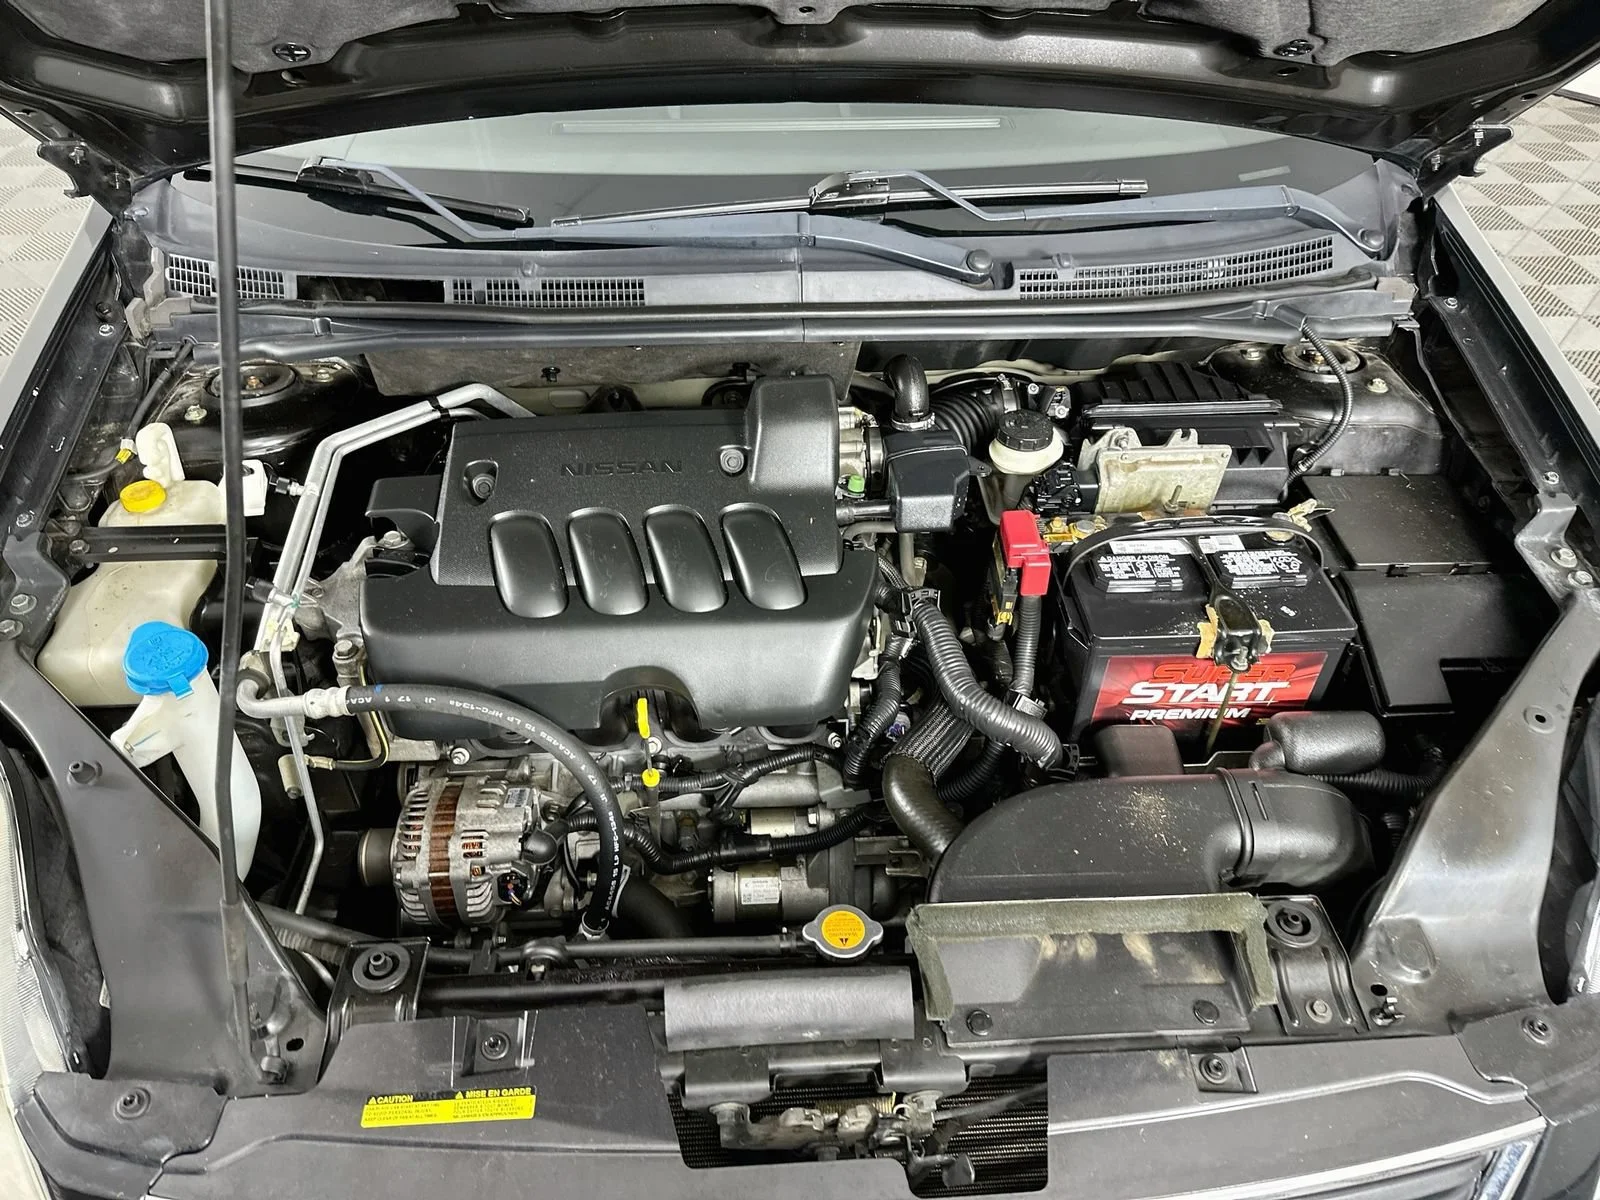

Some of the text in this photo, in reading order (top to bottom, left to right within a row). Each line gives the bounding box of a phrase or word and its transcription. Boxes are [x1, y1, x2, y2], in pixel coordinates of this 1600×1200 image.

[560, 461, 682, 477] NISSAN
[1150, 663, 1296, 682] SUPER
[397, 695, 412, 703] 17
[1122, 681, 1289, 704] START
[449, 700, 504, 718] HFC-134a
[1130, 707, 1252, 721] PREMIUM
[506, 716, 522, 725] LP
[377, 1095, 413, 1104] CAUTION
[466, 1087, 532, 1099] MISE EN GARDE
